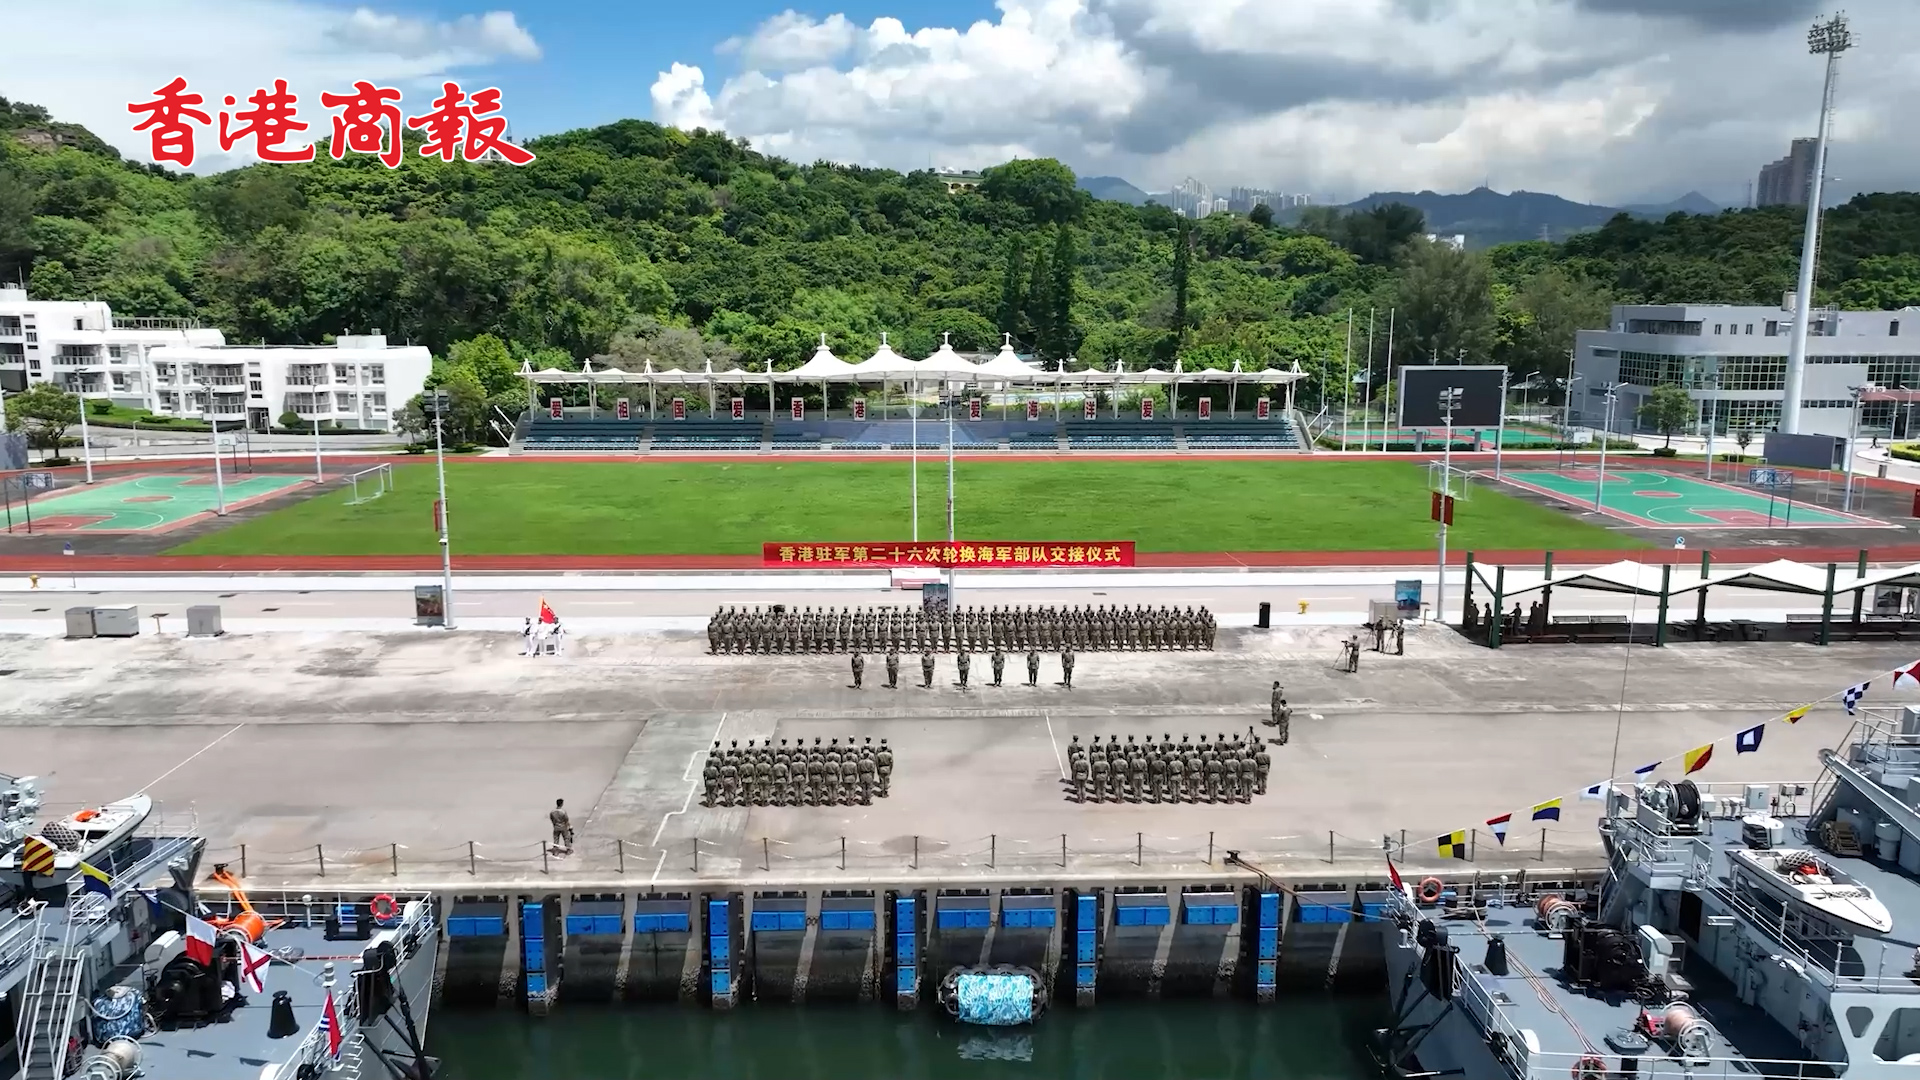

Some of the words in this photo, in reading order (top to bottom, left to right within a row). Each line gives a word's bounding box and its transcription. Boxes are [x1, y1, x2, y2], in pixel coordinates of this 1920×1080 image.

[779, 546, 1121, 563] 香港驻军第二十六次轮换海军部队交接仪式
